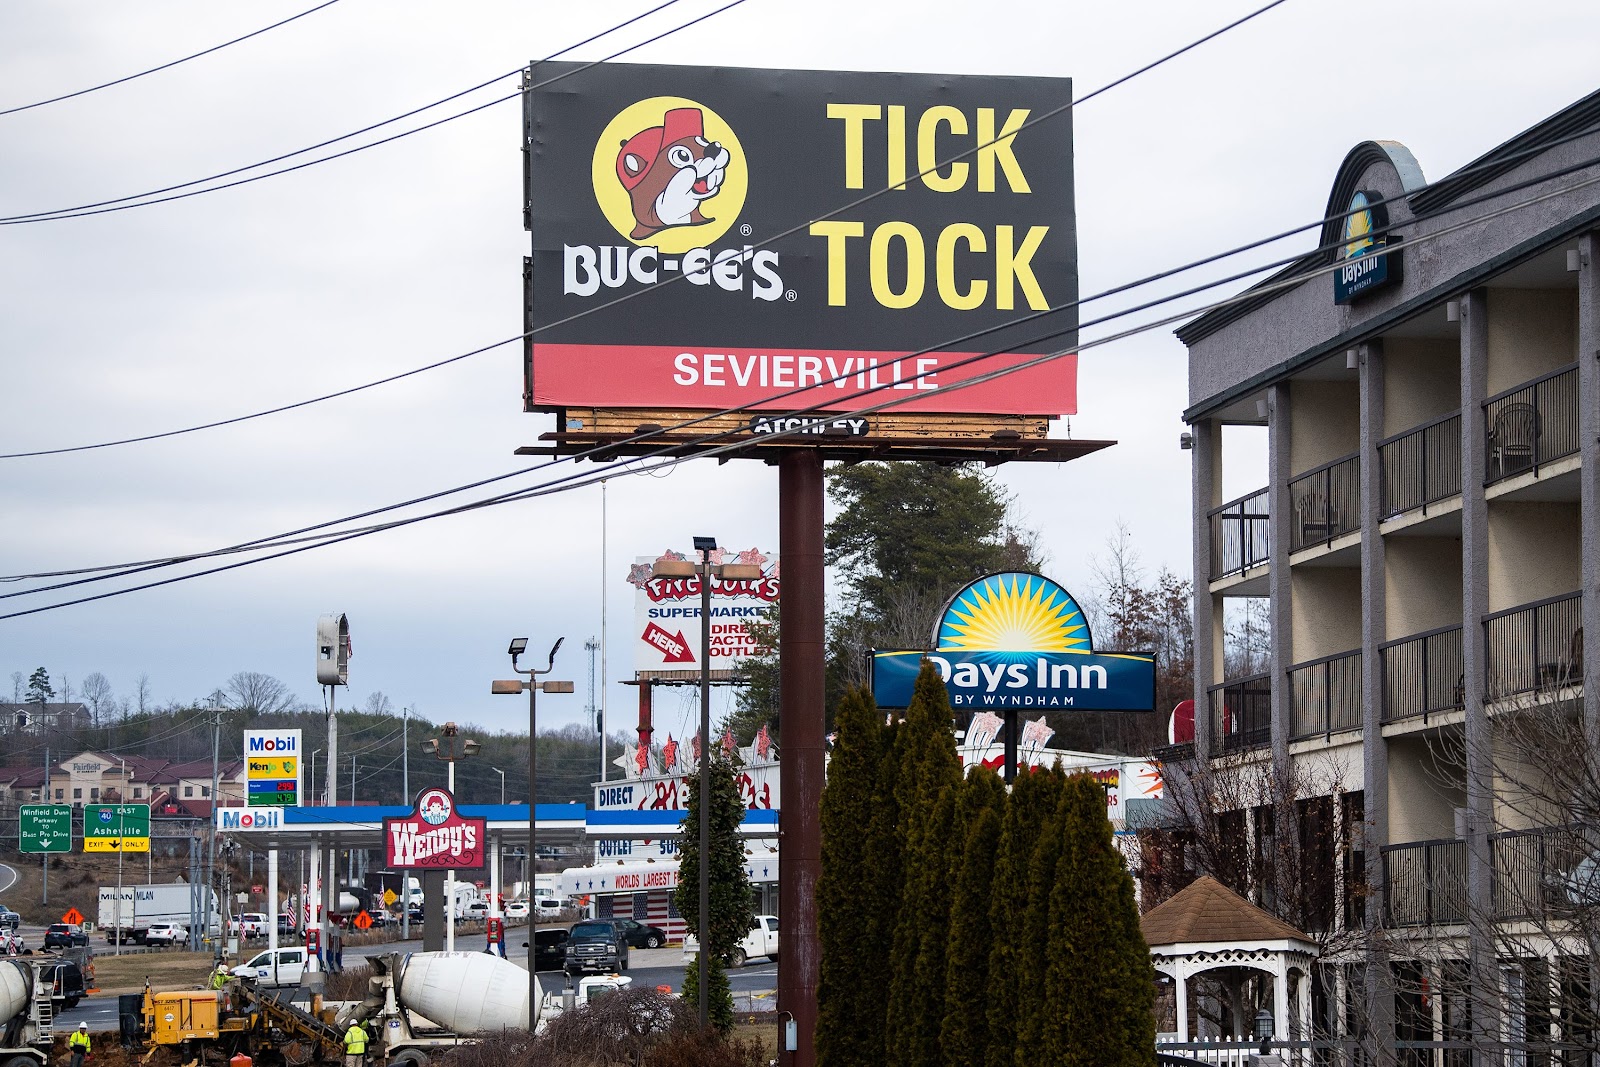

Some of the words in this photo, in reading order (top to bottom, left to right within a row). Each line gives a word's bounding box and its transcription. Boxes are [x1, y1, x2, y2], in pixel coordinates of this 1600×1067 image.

[827, 103, 1032, 194] TICK
[809, 220, 1050, 310] TOCK
[673, 353, 939, 390] SEVIERVILLE
[648, 628, 685, 659] HERE
[1037, 658, 1107, 689] Inn
[954, 695, 975, 704] BY
[983, 695, 1074, 706] WYNDHAM
[249, 736, 296, 751] Mobil
[599, 786, 634, 807] DIRECT
[101, 812, 112, 820] 40
[223, 811, 278, 828] Mobil
[390, 823, 476, 865] Wendy's
[599, 840, 632, 857] OUTLET
[615, 874, 640, 889] WORLDS
[643, 871, 671, 887] LARGEST
[136, 891, 154, 901] MILAN
